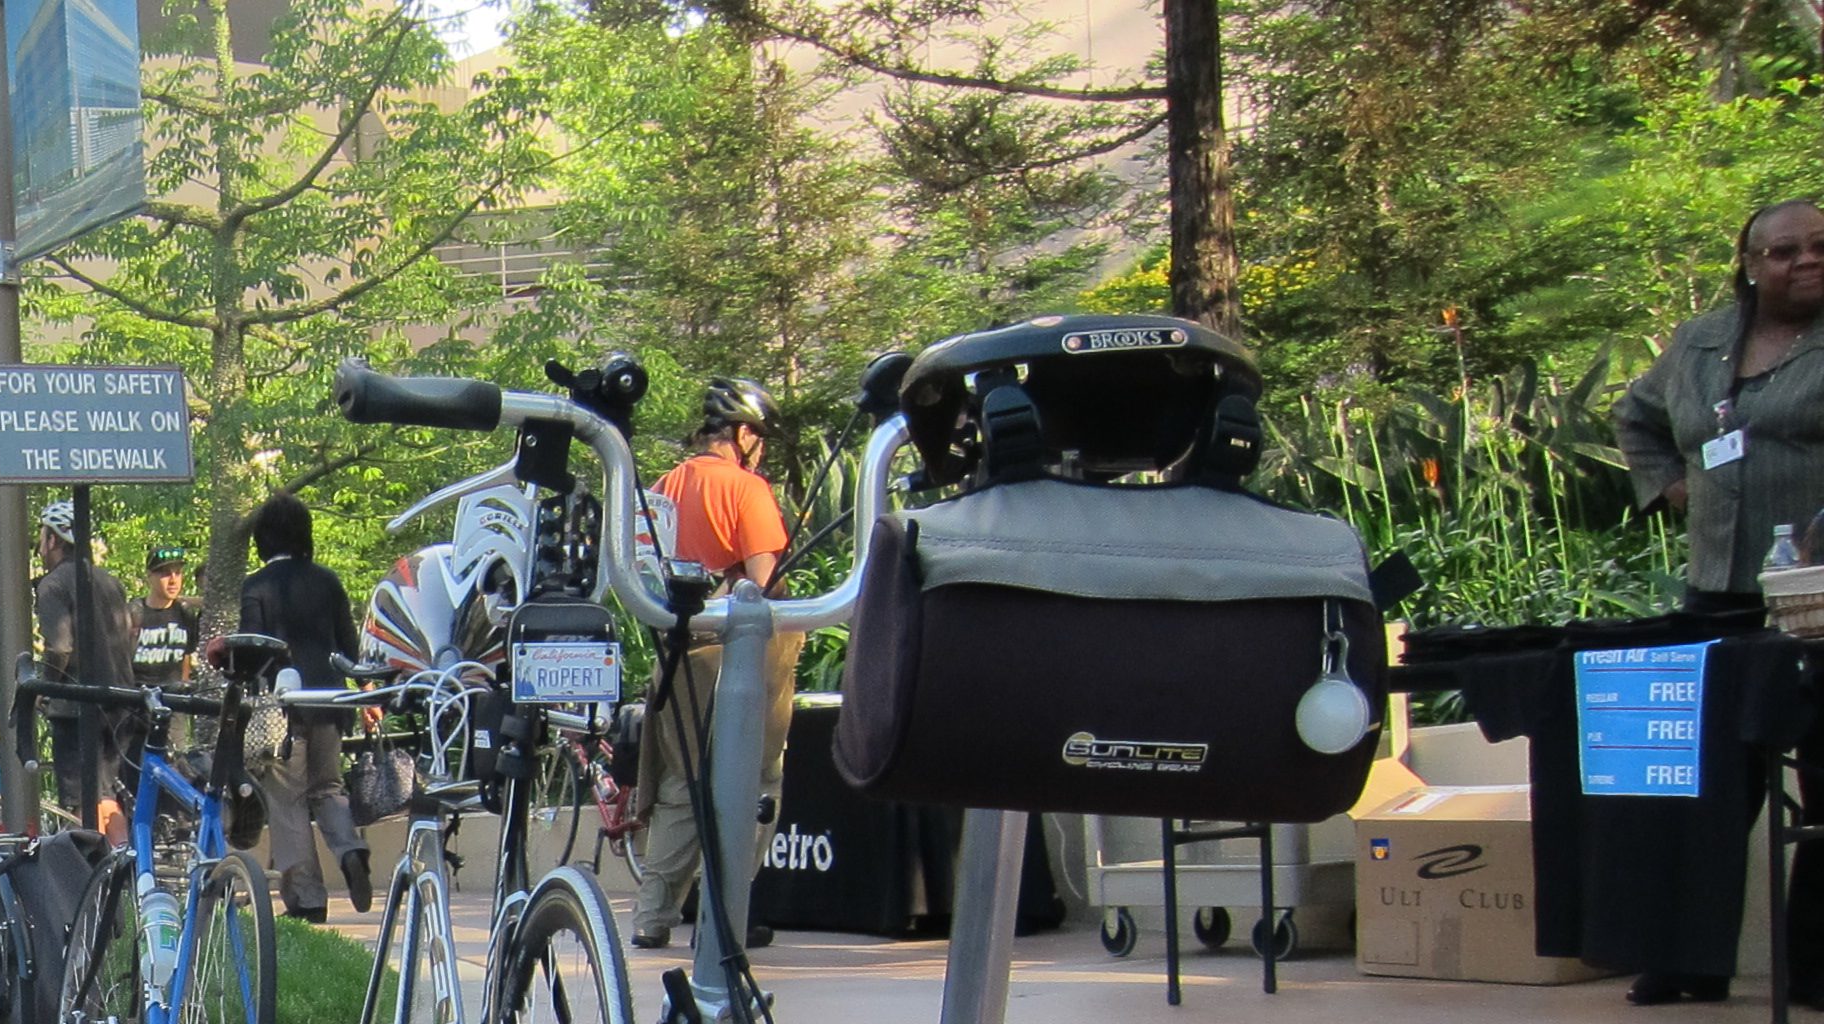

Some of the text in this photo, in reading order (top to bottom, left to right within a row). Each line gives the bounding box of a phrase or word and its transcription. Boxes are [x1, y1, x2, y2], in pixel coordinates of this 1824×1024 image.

[1089, 331, 1162, 348] BROOKS
[43, 373, 96, 394] YOUR
[104, 374, 175, 395] SAFETY
[0, 410, 180, 432] PLEASE WALK ON
[22, 448, 167, 470] THE SIDEWALK
[532, 646, 602, 663] California
[537, 667, 603, 688] RUPERT
[1649, 682, 1696, 702] FREE
[1647, 720, 1694, 740] FREE
[1067, 741, 1203, 760] SUNLITE
[1646, 765, 1693, 785] FREE
[763, 823, 833, 872] etro
[1460, 889, 1525, 910] CLUB
